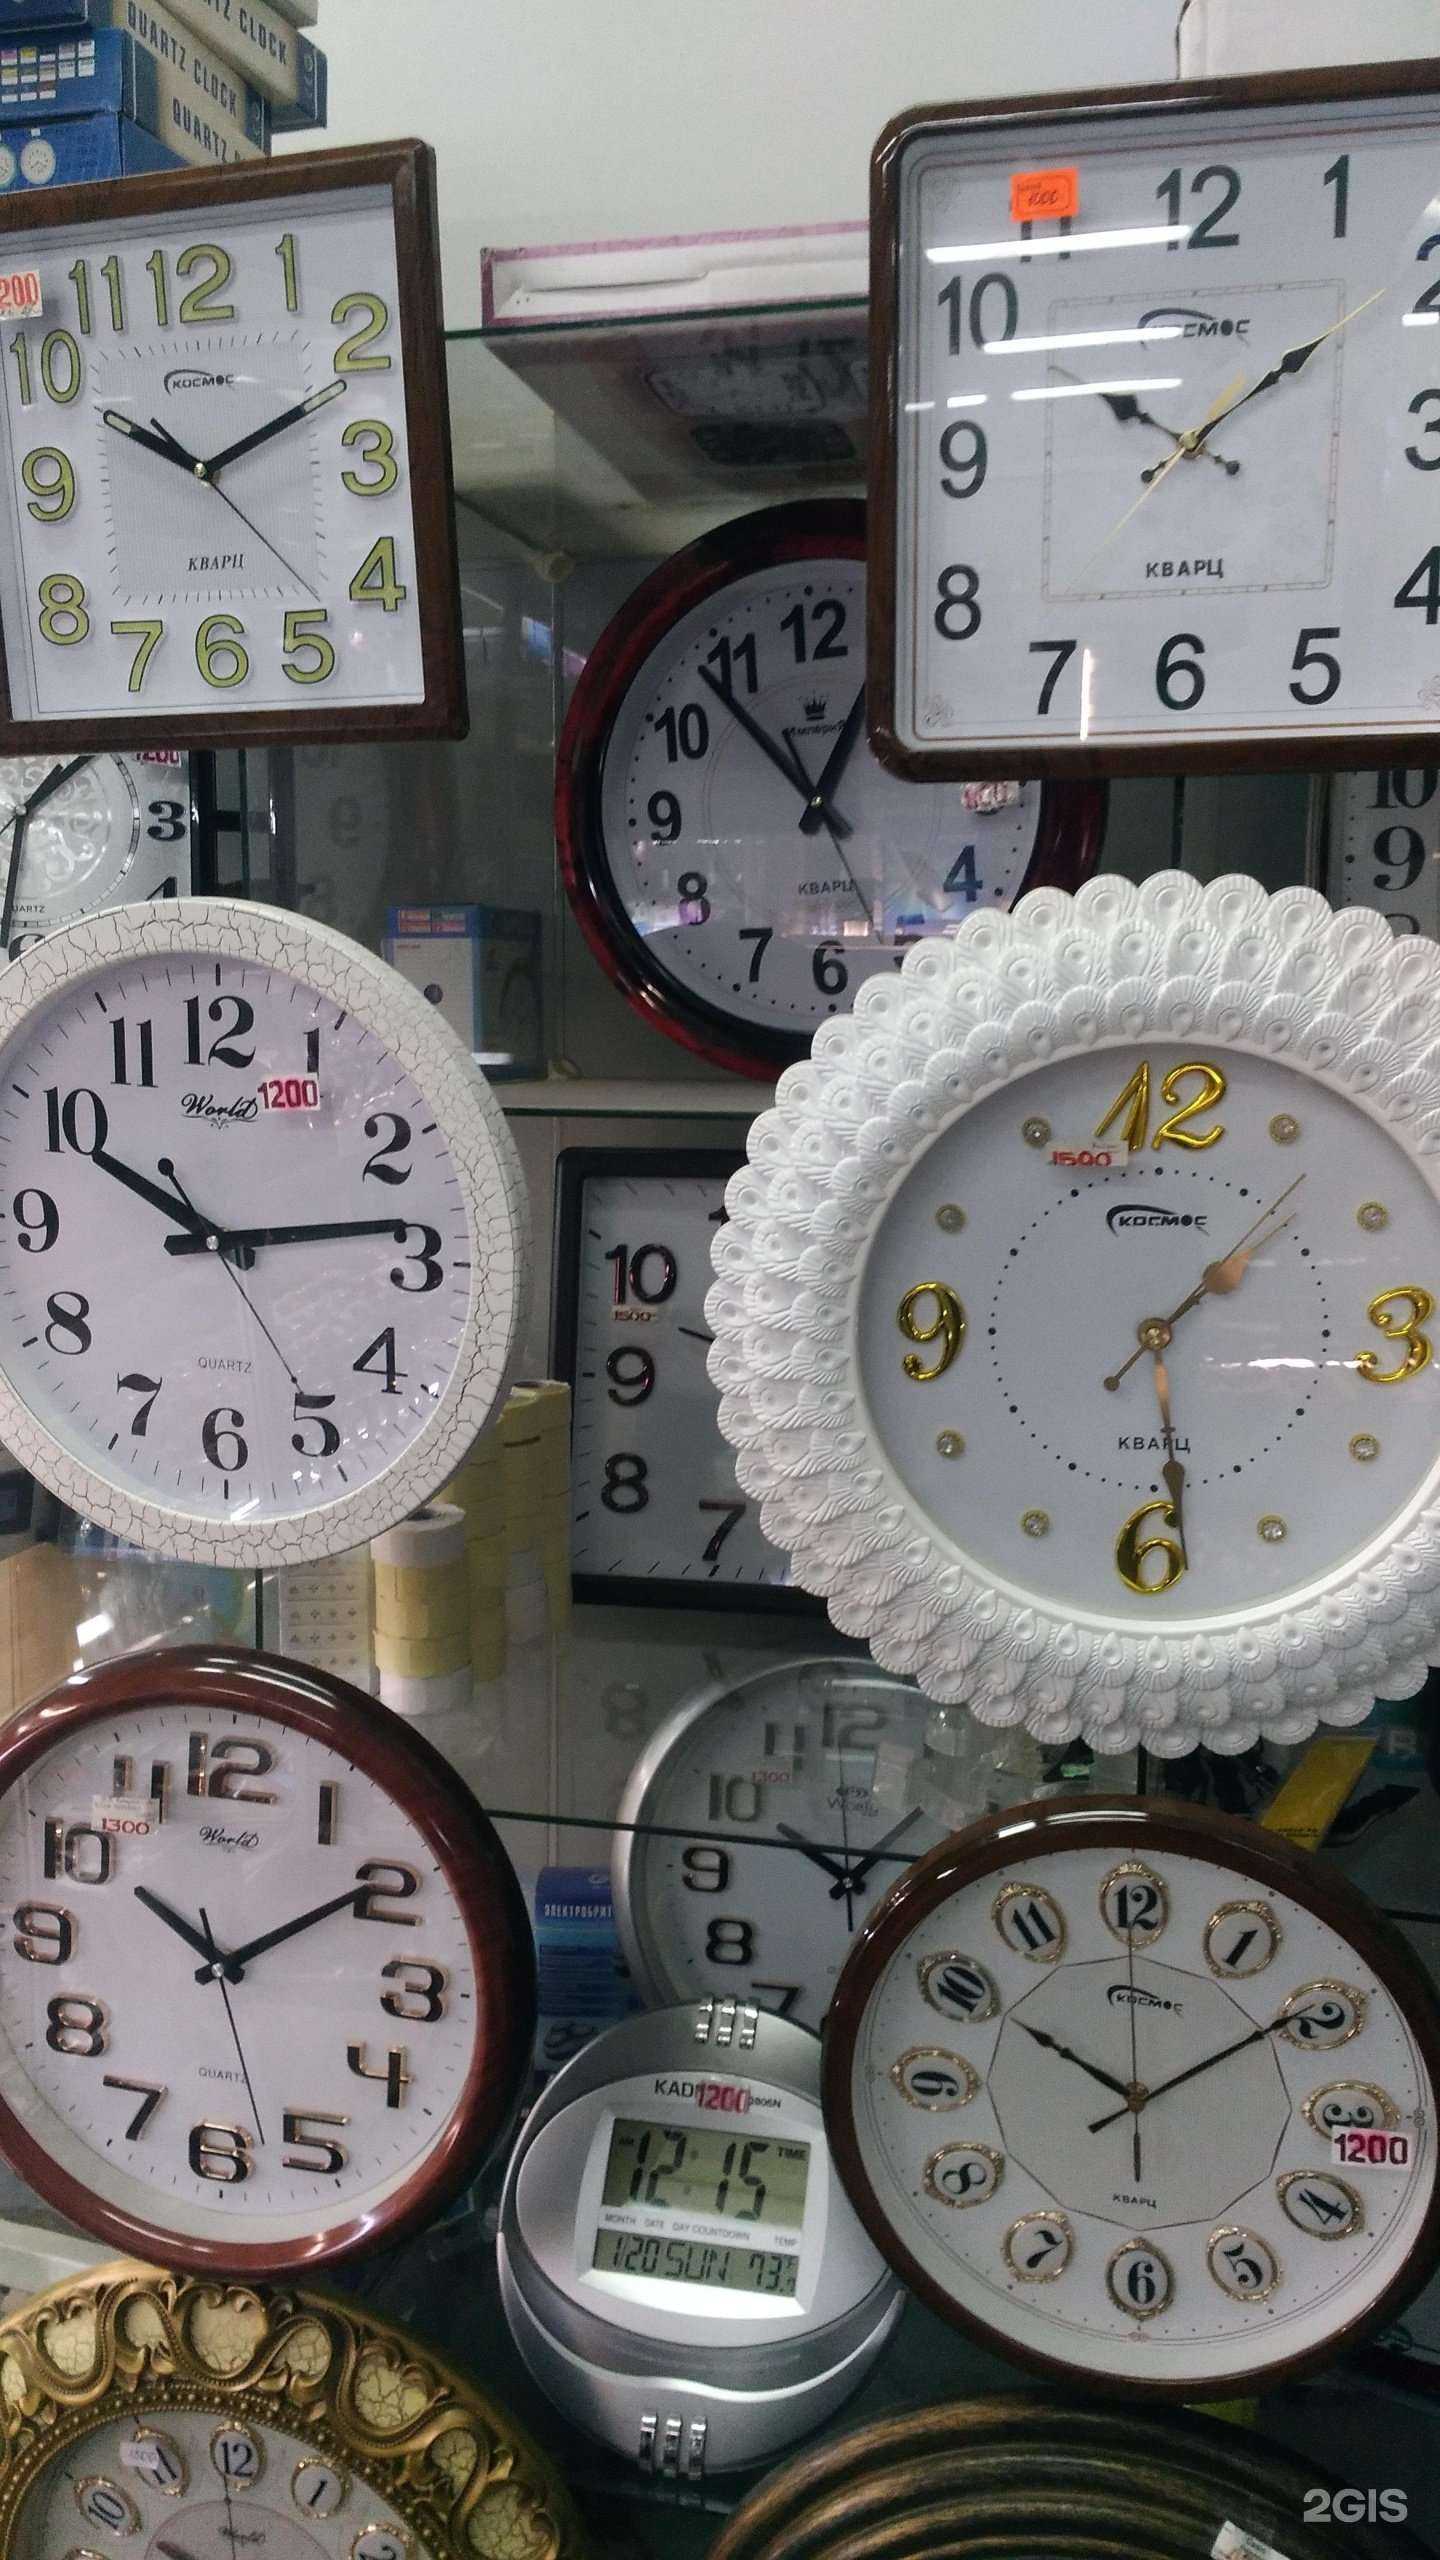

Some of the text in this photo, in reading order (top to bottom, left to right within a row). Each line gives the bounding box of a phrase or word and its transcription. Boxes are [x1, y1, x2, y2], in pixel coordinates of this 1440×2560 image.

[127, 0, 186, 73] QUARTZ
[193, 57, 237, 118] CLOCK
[239, 7, 287, 65] CLOCK
[172, 97, 228, 163] QUARTZ
[1156, 164, 1242, 251] 12
[1322, 153, 1351, 239] 1
[68, 255, 124, 335] 11
[146, 243, 234, 326] 12
[275, 233, 299, 312] 1
[331, 292, 391, 373] 2
[937, 272, 1018, 356] 10
[9, 328, 82, 405] 10
[21, 446, 75, 522] 9
[341, 419, 398, 497] 3
[939, 420, 988, 499] 9
[187, 554, 245, 573] КВАРЦ
[349, 536, 406, 612] 4
[1145, 558, 1225, 579] КВАРЦ
[38, 573, 90, 646] 8
[780, 599, 849, 664] 12
[934, 564, 982, 641] 8
[110, 619, 163, 692] 7
[195, 614, 249, 688] 6
[281, 608, 335, 684] 5
[706, 632, 759, 694] 11
[1028, 639, 1078, 716] 7
[1155, 633, 1206, 711] 6
[1289, 627, 1341, 705] 5
[654, 702, 710, 763] 10
[147, 800, 186, 842] 3
[647, 790, 683, 841] 9
[942, 844, 984, 902] 4
[1374, 826, 1426, 891] 9
[677, 871, 712, 925] 8
[739, 927, 774, 983] 7
[811, 939, 849, 994] 6
[109, 1016, 159, 1088] 11
[183, 995, 255, 1070] 12
[43, 1086, 109, 1157] 10
[181, 1093, 258, 1120] World
[257, 1078, 319, 1110] 1200
[1094, 1060, 1228, 1151] 12
[362, 1112, 413, 1185] 2
[13, 1188, 59, 1253] 9
[390, 1222, 444, 1293] 3
[605, 1243, 678, 1305] 10
[45, 1291, 92, 1355] 8
[897, 1281, 967, 1383] 9
[1354, 1285, 1435, 1383] 3
[198, 1356, 254, 1374] QUARTZ
[352, 1327, 408, 1395] 4
[606, 1346, 656, 1407] 9
[117, 1372, 163, 1437] 7
[291, 1391, 341, 1458] 5
[202, 1408, 249, 1472] 6
[601, 1452, 649, 1514] 8
[698, 1500, 746, 1562] 7
[1114, 1501, 1187, 1594] 6
[187, 1730, 279, 1807] 12
[708, 1772, 764, 1823] 10
[101, 1817, 151, 1836] 1300
[200, 1825, 260, 1849] World
[318, 1780, 340, 1846] 1
[44, 1815, 117, 1886] 10
[681, 1846, 730, 1893] 9
[353, 1858, 424, 1927] 2
[1009, 1900, 1056, 1951] 11
[1112, 1884, 1160, 1931] 12
[12, 1900, 82, 1966] 9
[705, 1918, 754, 1966] 8
[1222, 1927, 1258, 1967] 1
[380, 1957, 450, 2023] 3
[936, 1965, 986, 2014] 10
[46, 1992, 111, 2058] 8
[346, 2039, 416, 2109] 4
[103, 2074, 168, 2142] 7
[282, 2107, 352, 2175] 5
[188, 2117, 255, 2185] 6
[1333, 2132, 1409, 2165] 1200
[605, 2213, 637, 2225] MONTH
[1127, 2258, 1156, 2304] 6
[221, 2441, 253, 2478] 12
[87, 2490, 126, 2531] 10
